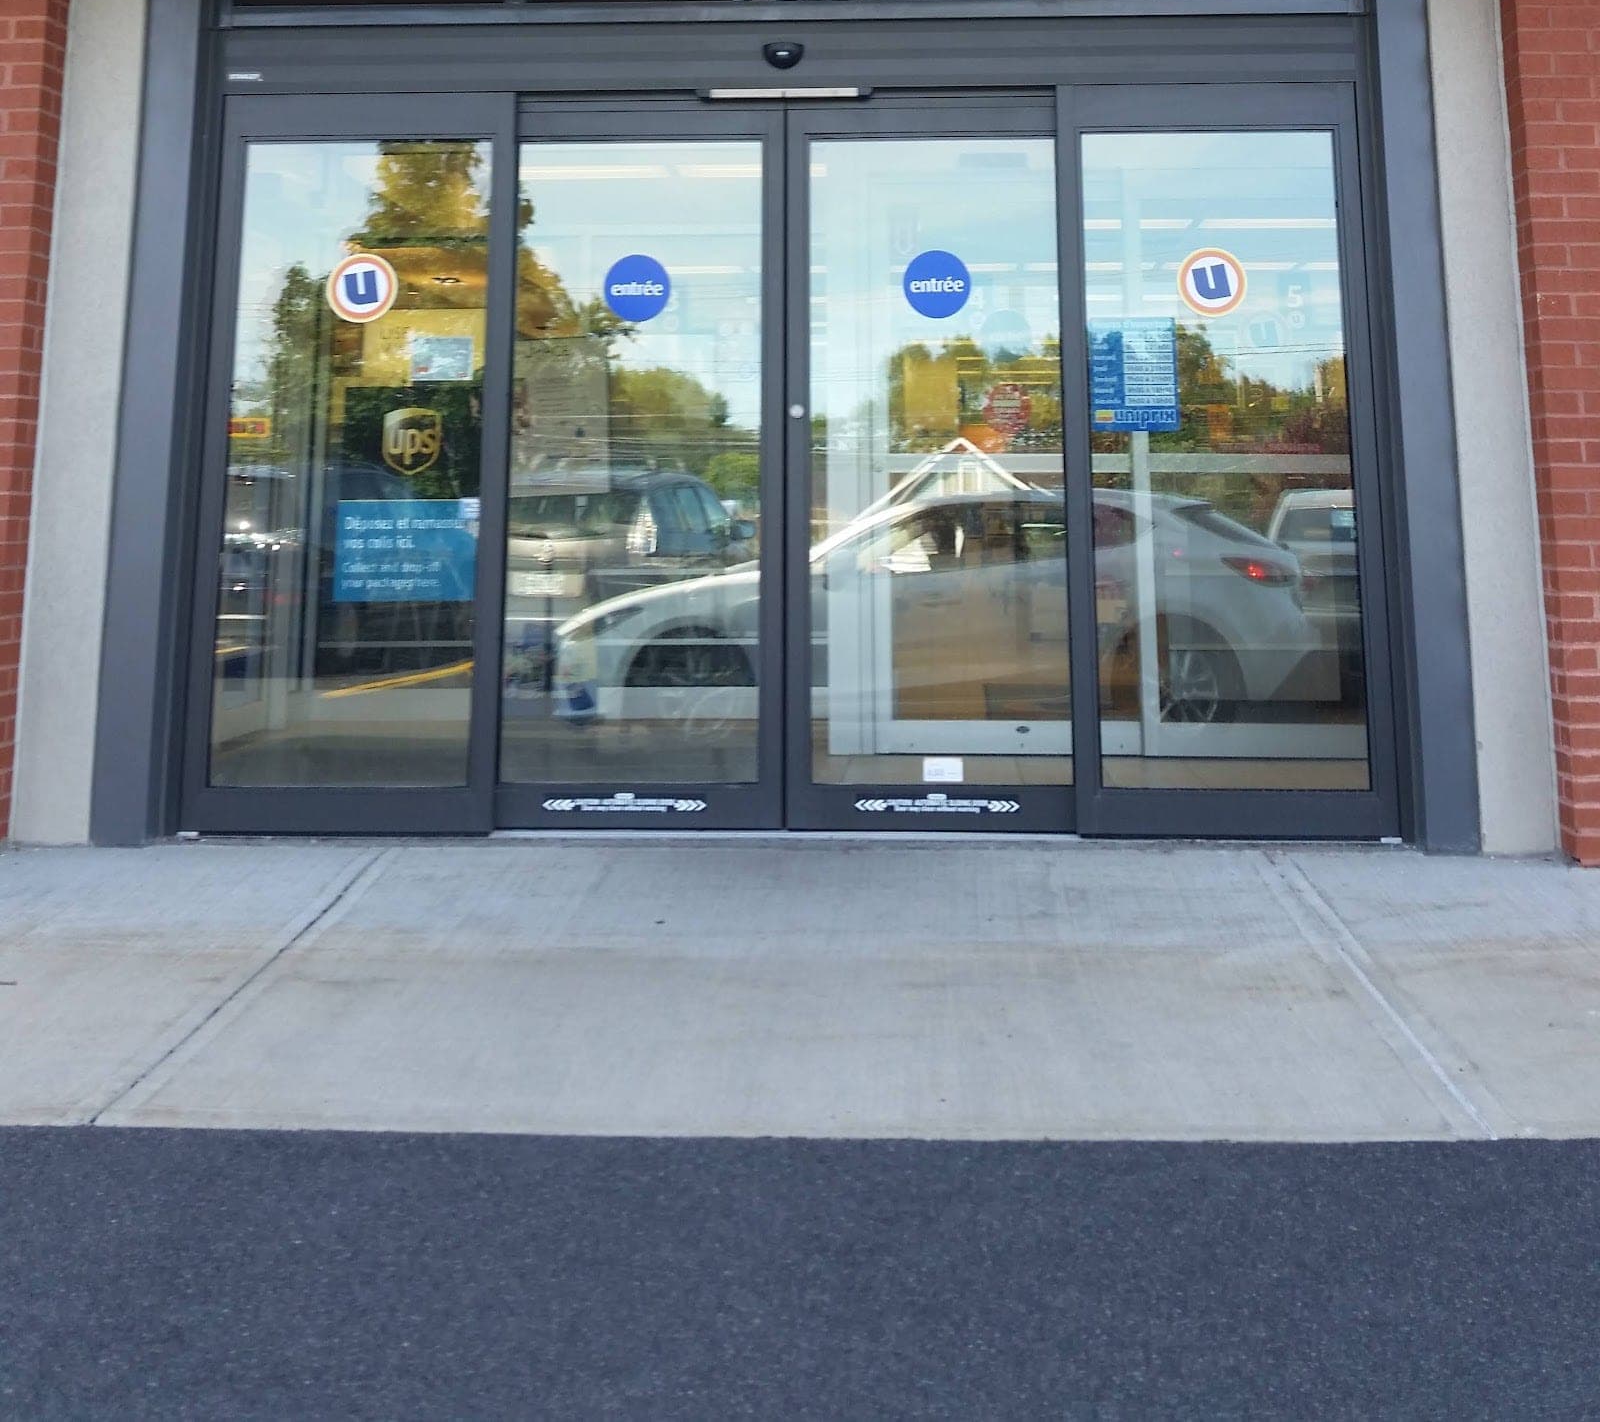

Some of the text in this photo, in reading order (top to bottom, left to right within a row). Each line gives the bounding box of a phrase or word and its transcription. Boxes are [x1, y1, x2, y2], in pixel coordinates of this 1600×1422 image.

[610, 280, 664, 296] entrée
[909, 276, 965, 293] entrée
[1288, 284, 1302, 308] 5
[1113, 408, 1177, 429] uniprix
[389, 428, 438, 466] ups
[396, 517, 409, 529] et
